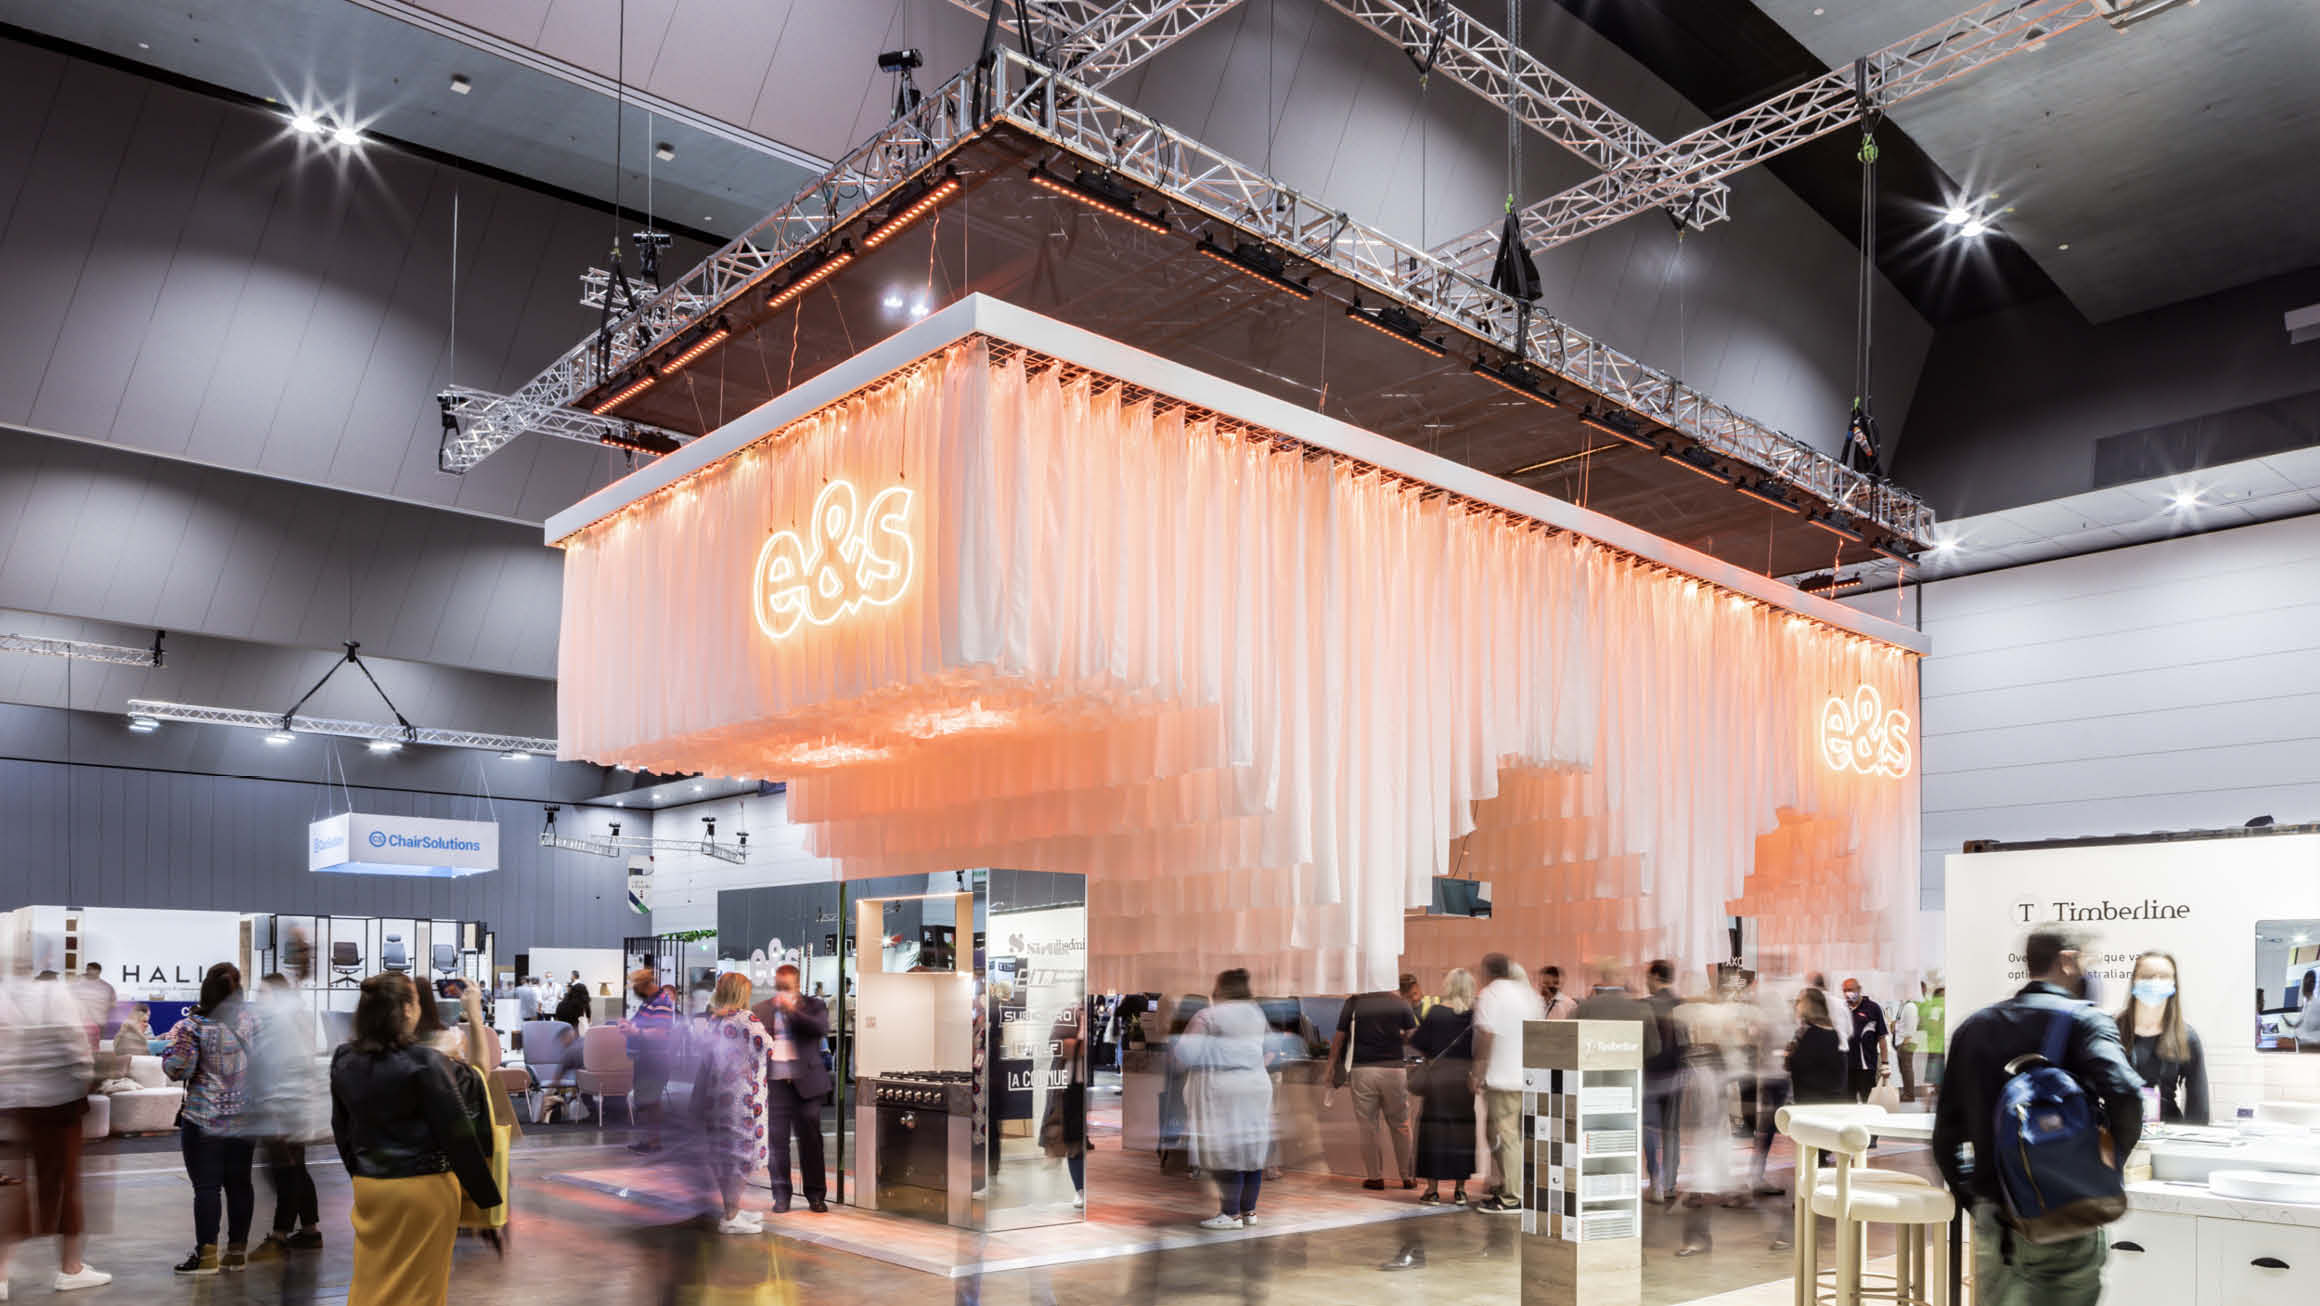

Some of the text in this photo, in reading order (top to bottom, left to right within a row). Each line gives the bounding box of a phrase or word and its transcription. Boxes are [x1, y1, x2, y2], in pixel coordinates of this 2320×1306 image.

[755, 479, 914, 639] e&s
[388, 833, 481, 852] ChairSolutions
[2018, 900, 2190, 922] T Timberline
[2008, 953, 2028, 963] Ove
[122, 965, 203, 983] HALI
[2008, 969, 2029, 980] opti
